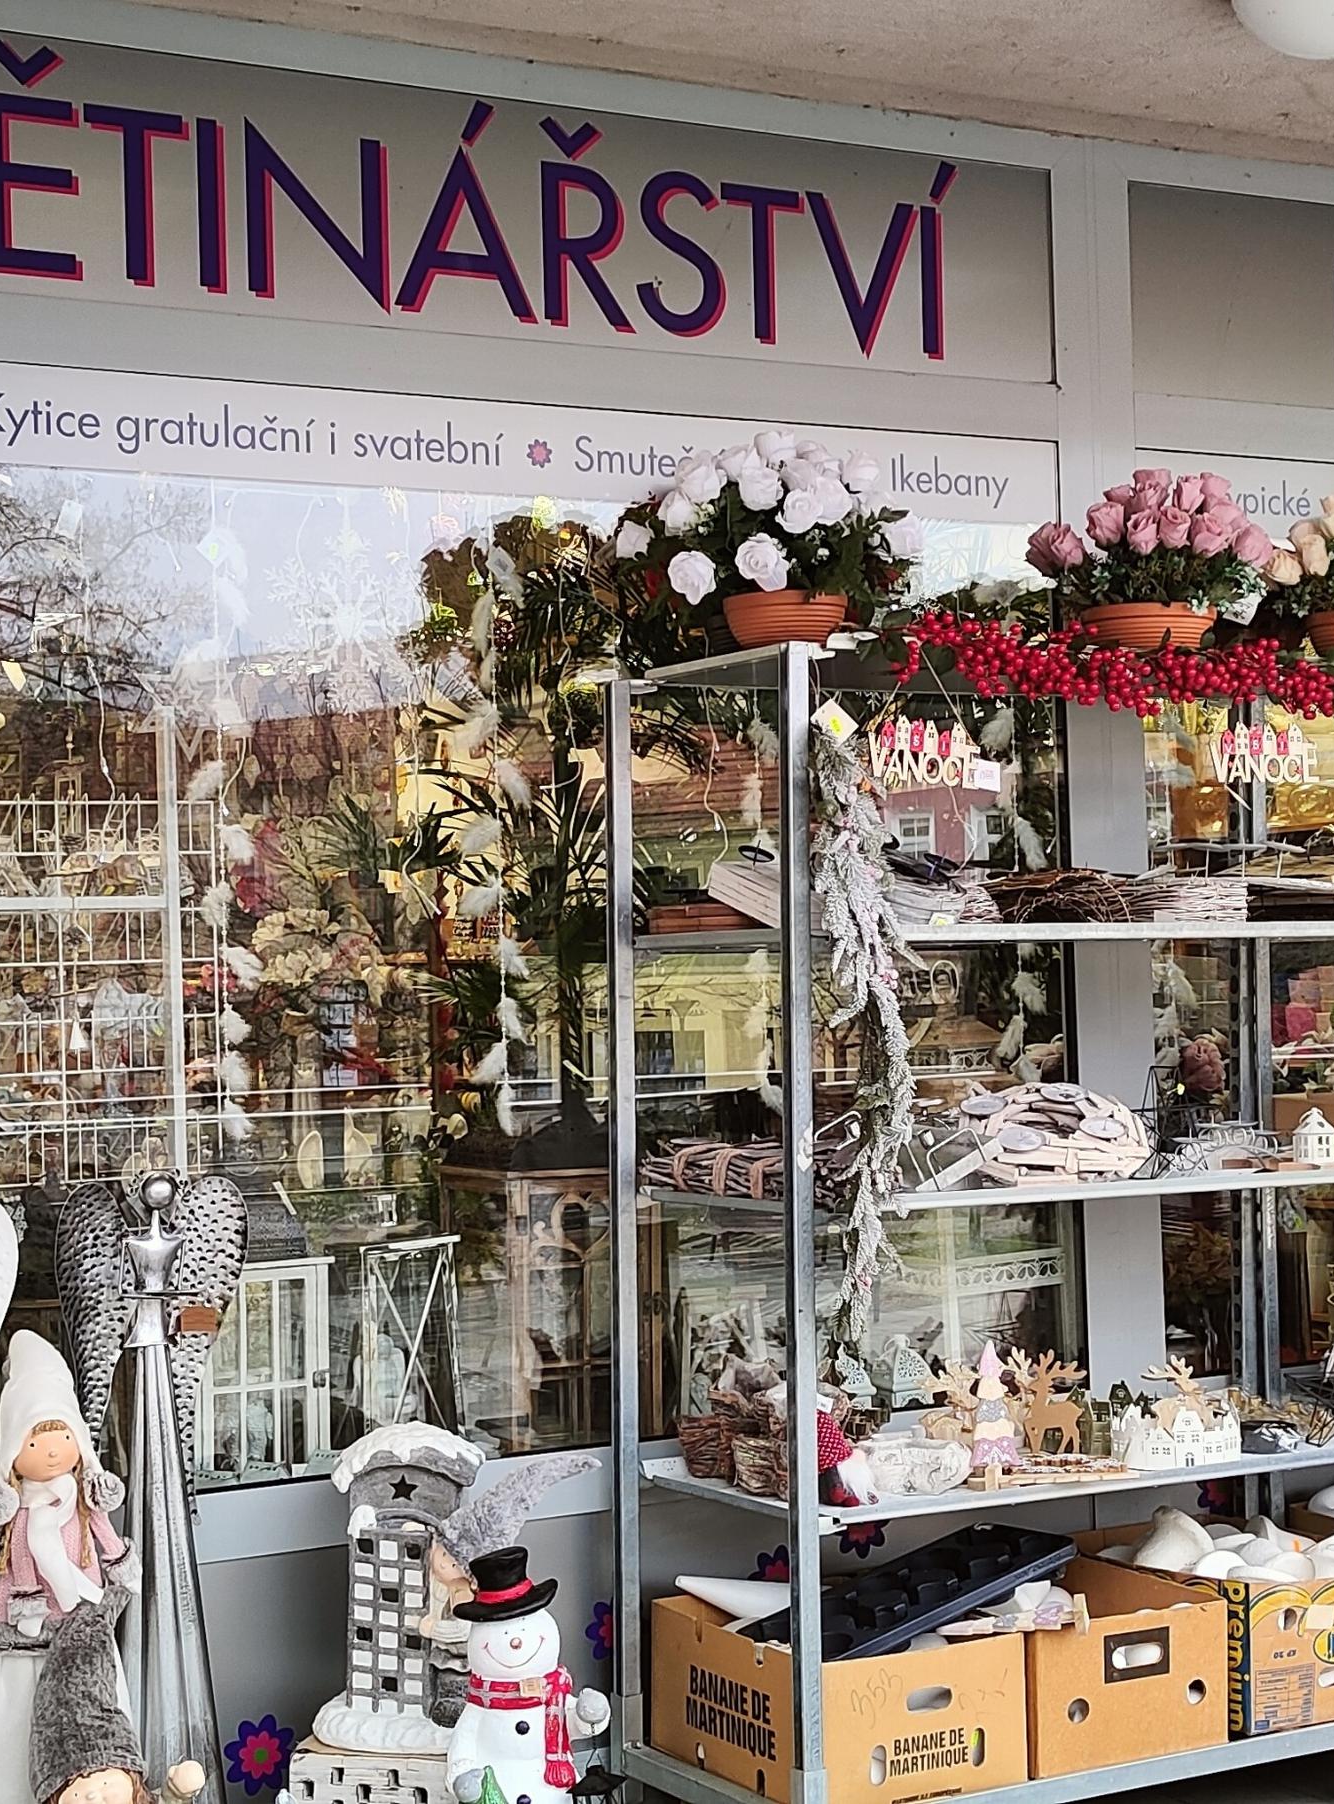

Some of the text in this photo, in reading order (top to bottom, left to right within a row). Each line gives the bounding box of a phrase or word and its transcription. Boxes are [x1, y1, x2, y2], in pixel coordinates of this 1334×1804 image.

[117, 403, 315, 455] gratulační
[329, 422, 336, 453] i
[353, 421, 505, 468] svatební
[890, 453, 1010, 509] Ikebany
[1222, 1580, 1250, 1732] premium
[689, 1664, 772, 1726] BANANE DE
[685, 1695, 777, 1762] MARTINIQUE
[893, 1727, 965, 1757] BANANE DE
[889, 1746, 969, 1777] MARTINIQUE
